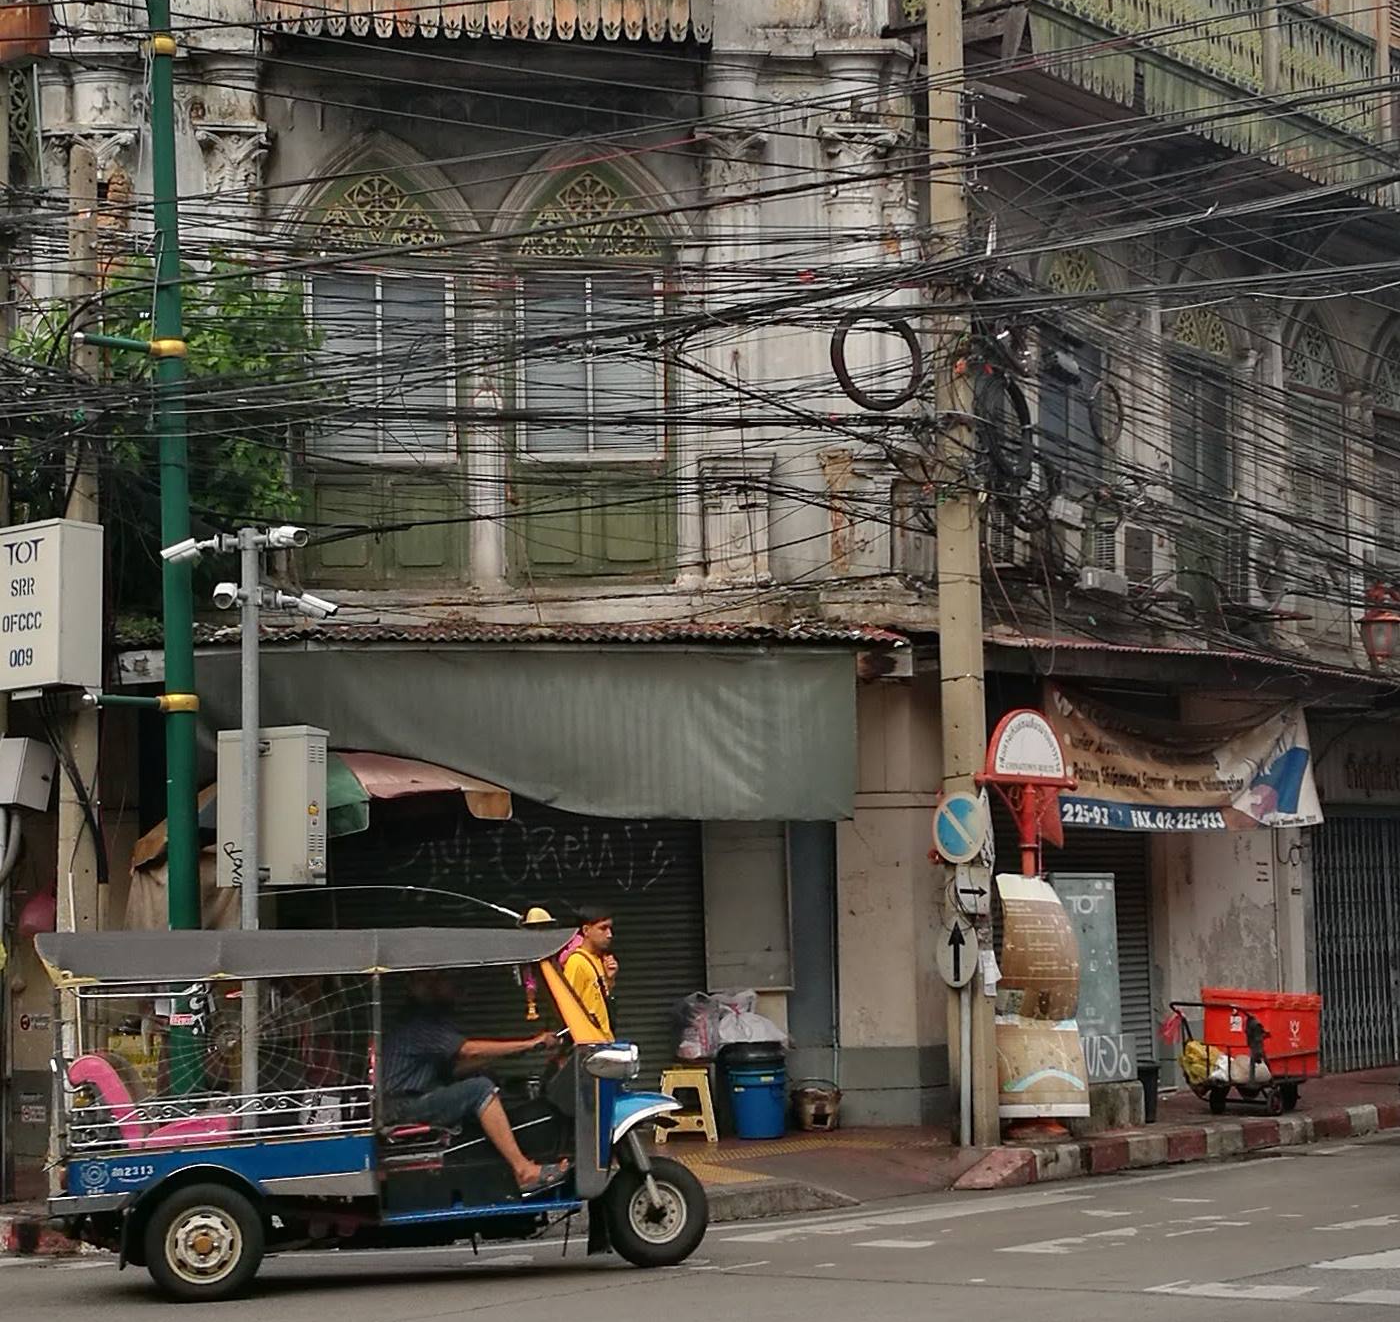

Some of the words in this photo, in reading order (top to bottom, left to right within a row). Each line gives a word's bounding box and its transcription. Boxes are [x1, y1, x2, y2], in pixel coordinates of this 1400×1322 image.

[3, 538, 45, 566] TOT
[11, 577, 35, 597] SRR
[9, 648, 33, 667] 009
[1065, 894, 1104, 914] TOT
